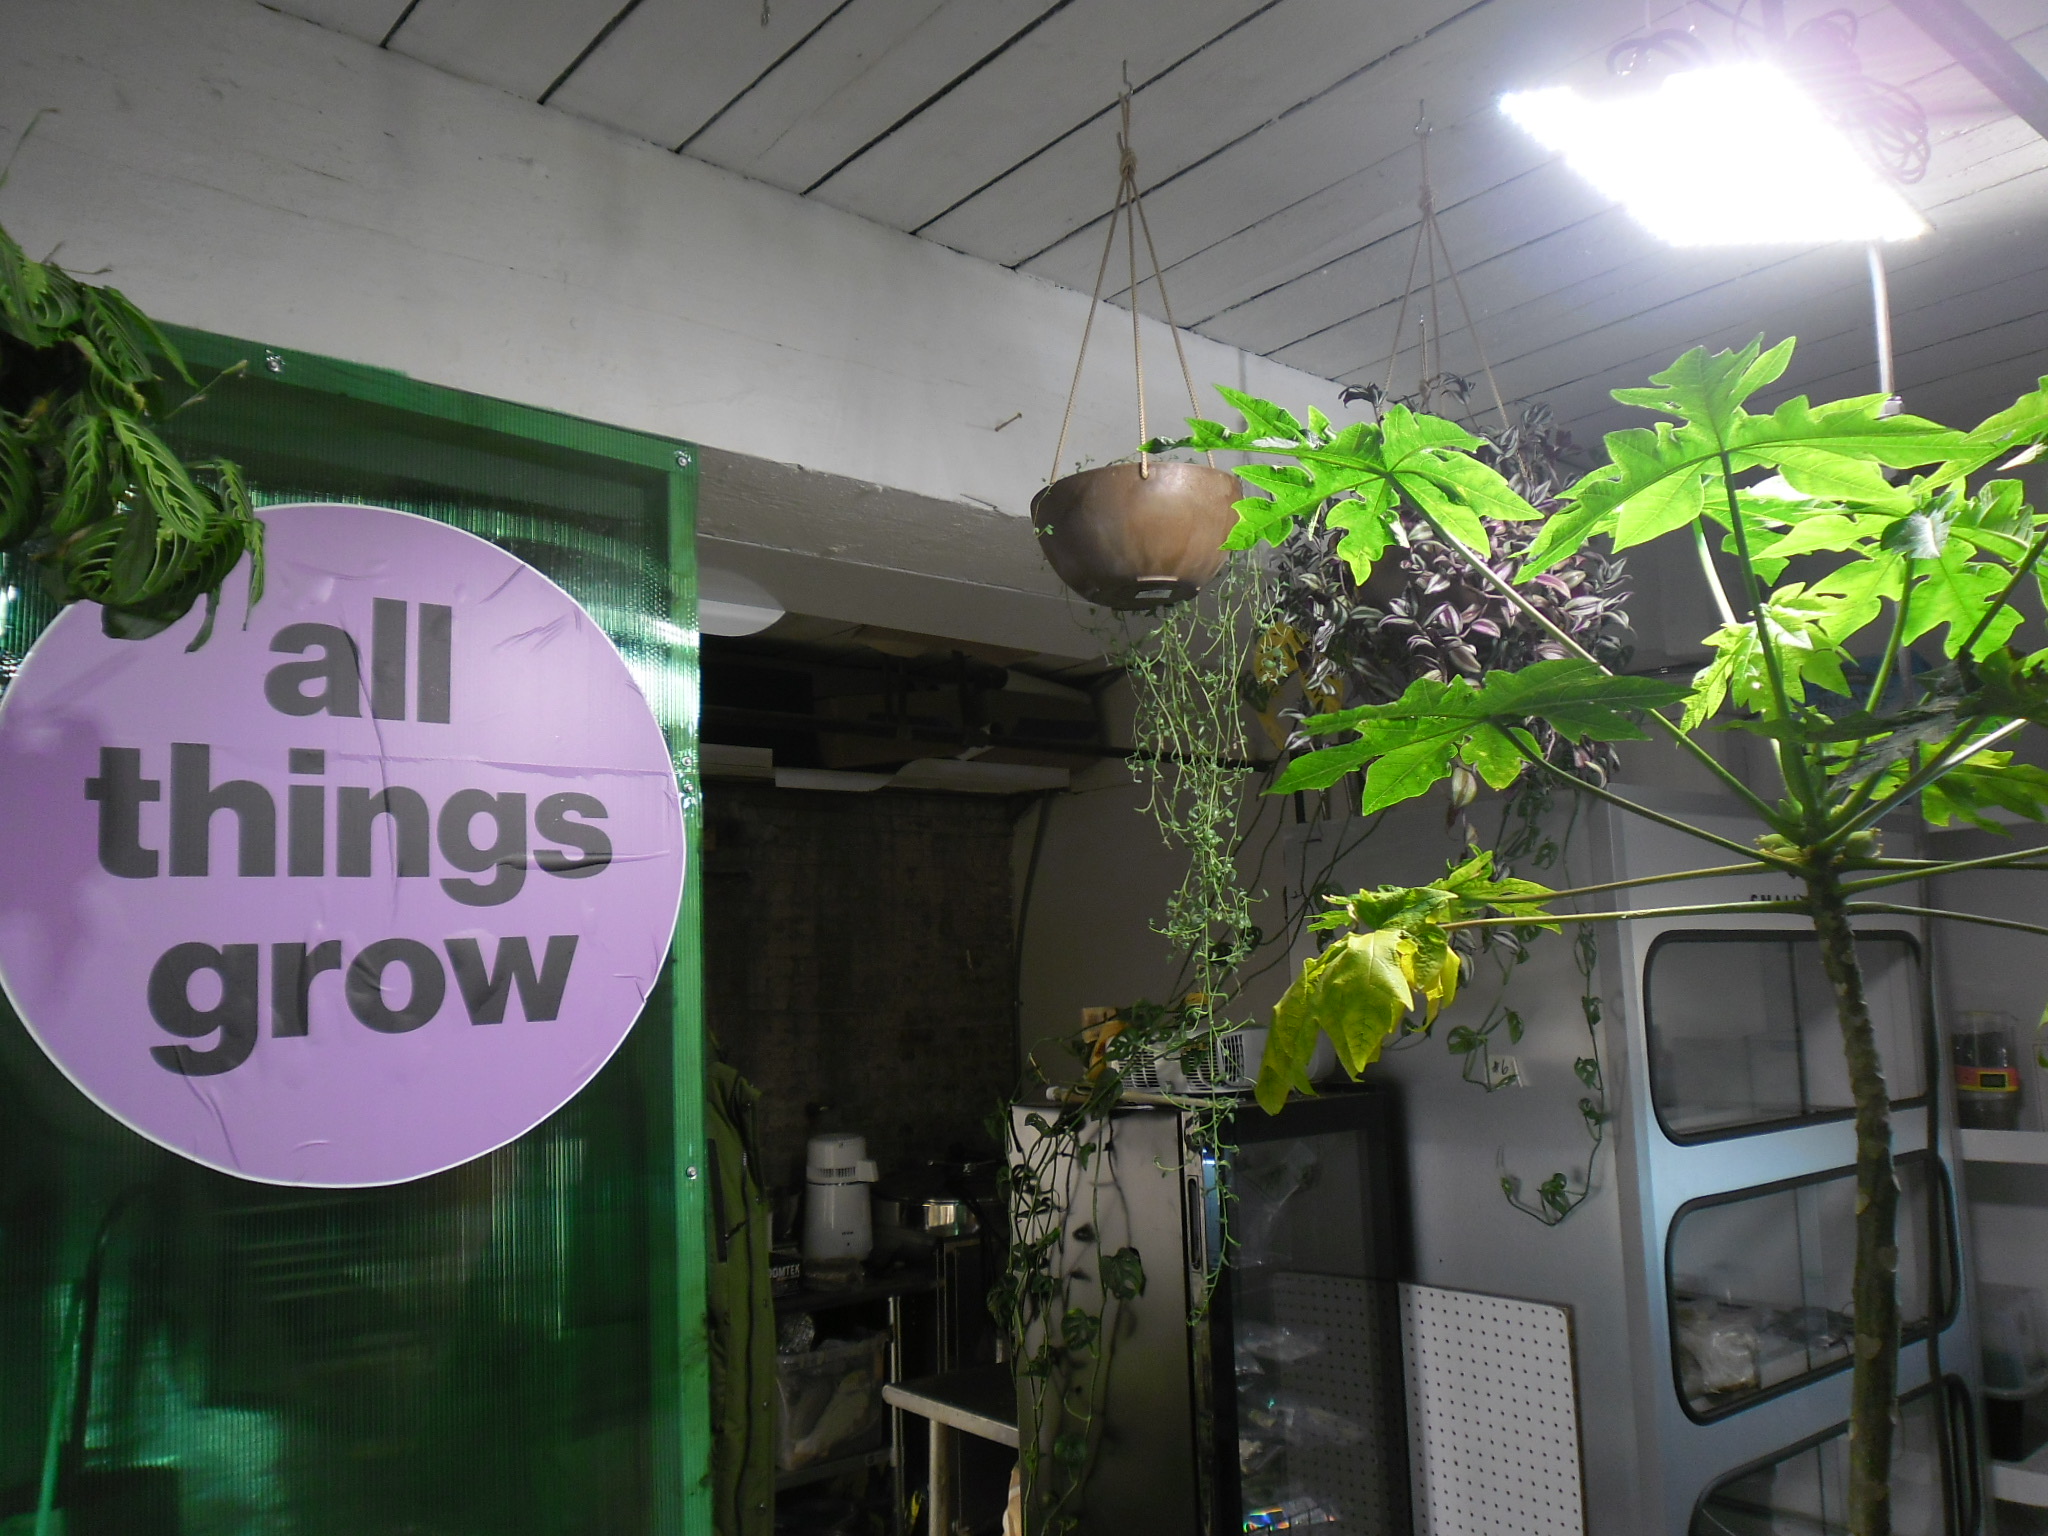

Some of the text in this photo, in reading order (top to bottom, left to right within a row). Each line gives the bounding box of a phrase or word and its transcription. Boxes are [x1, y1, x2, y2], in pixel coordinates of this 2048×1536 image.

[264, 597, 452, 724] all
[84, 742, 613, 907] things
[147, 934, 579, 1077] grow
